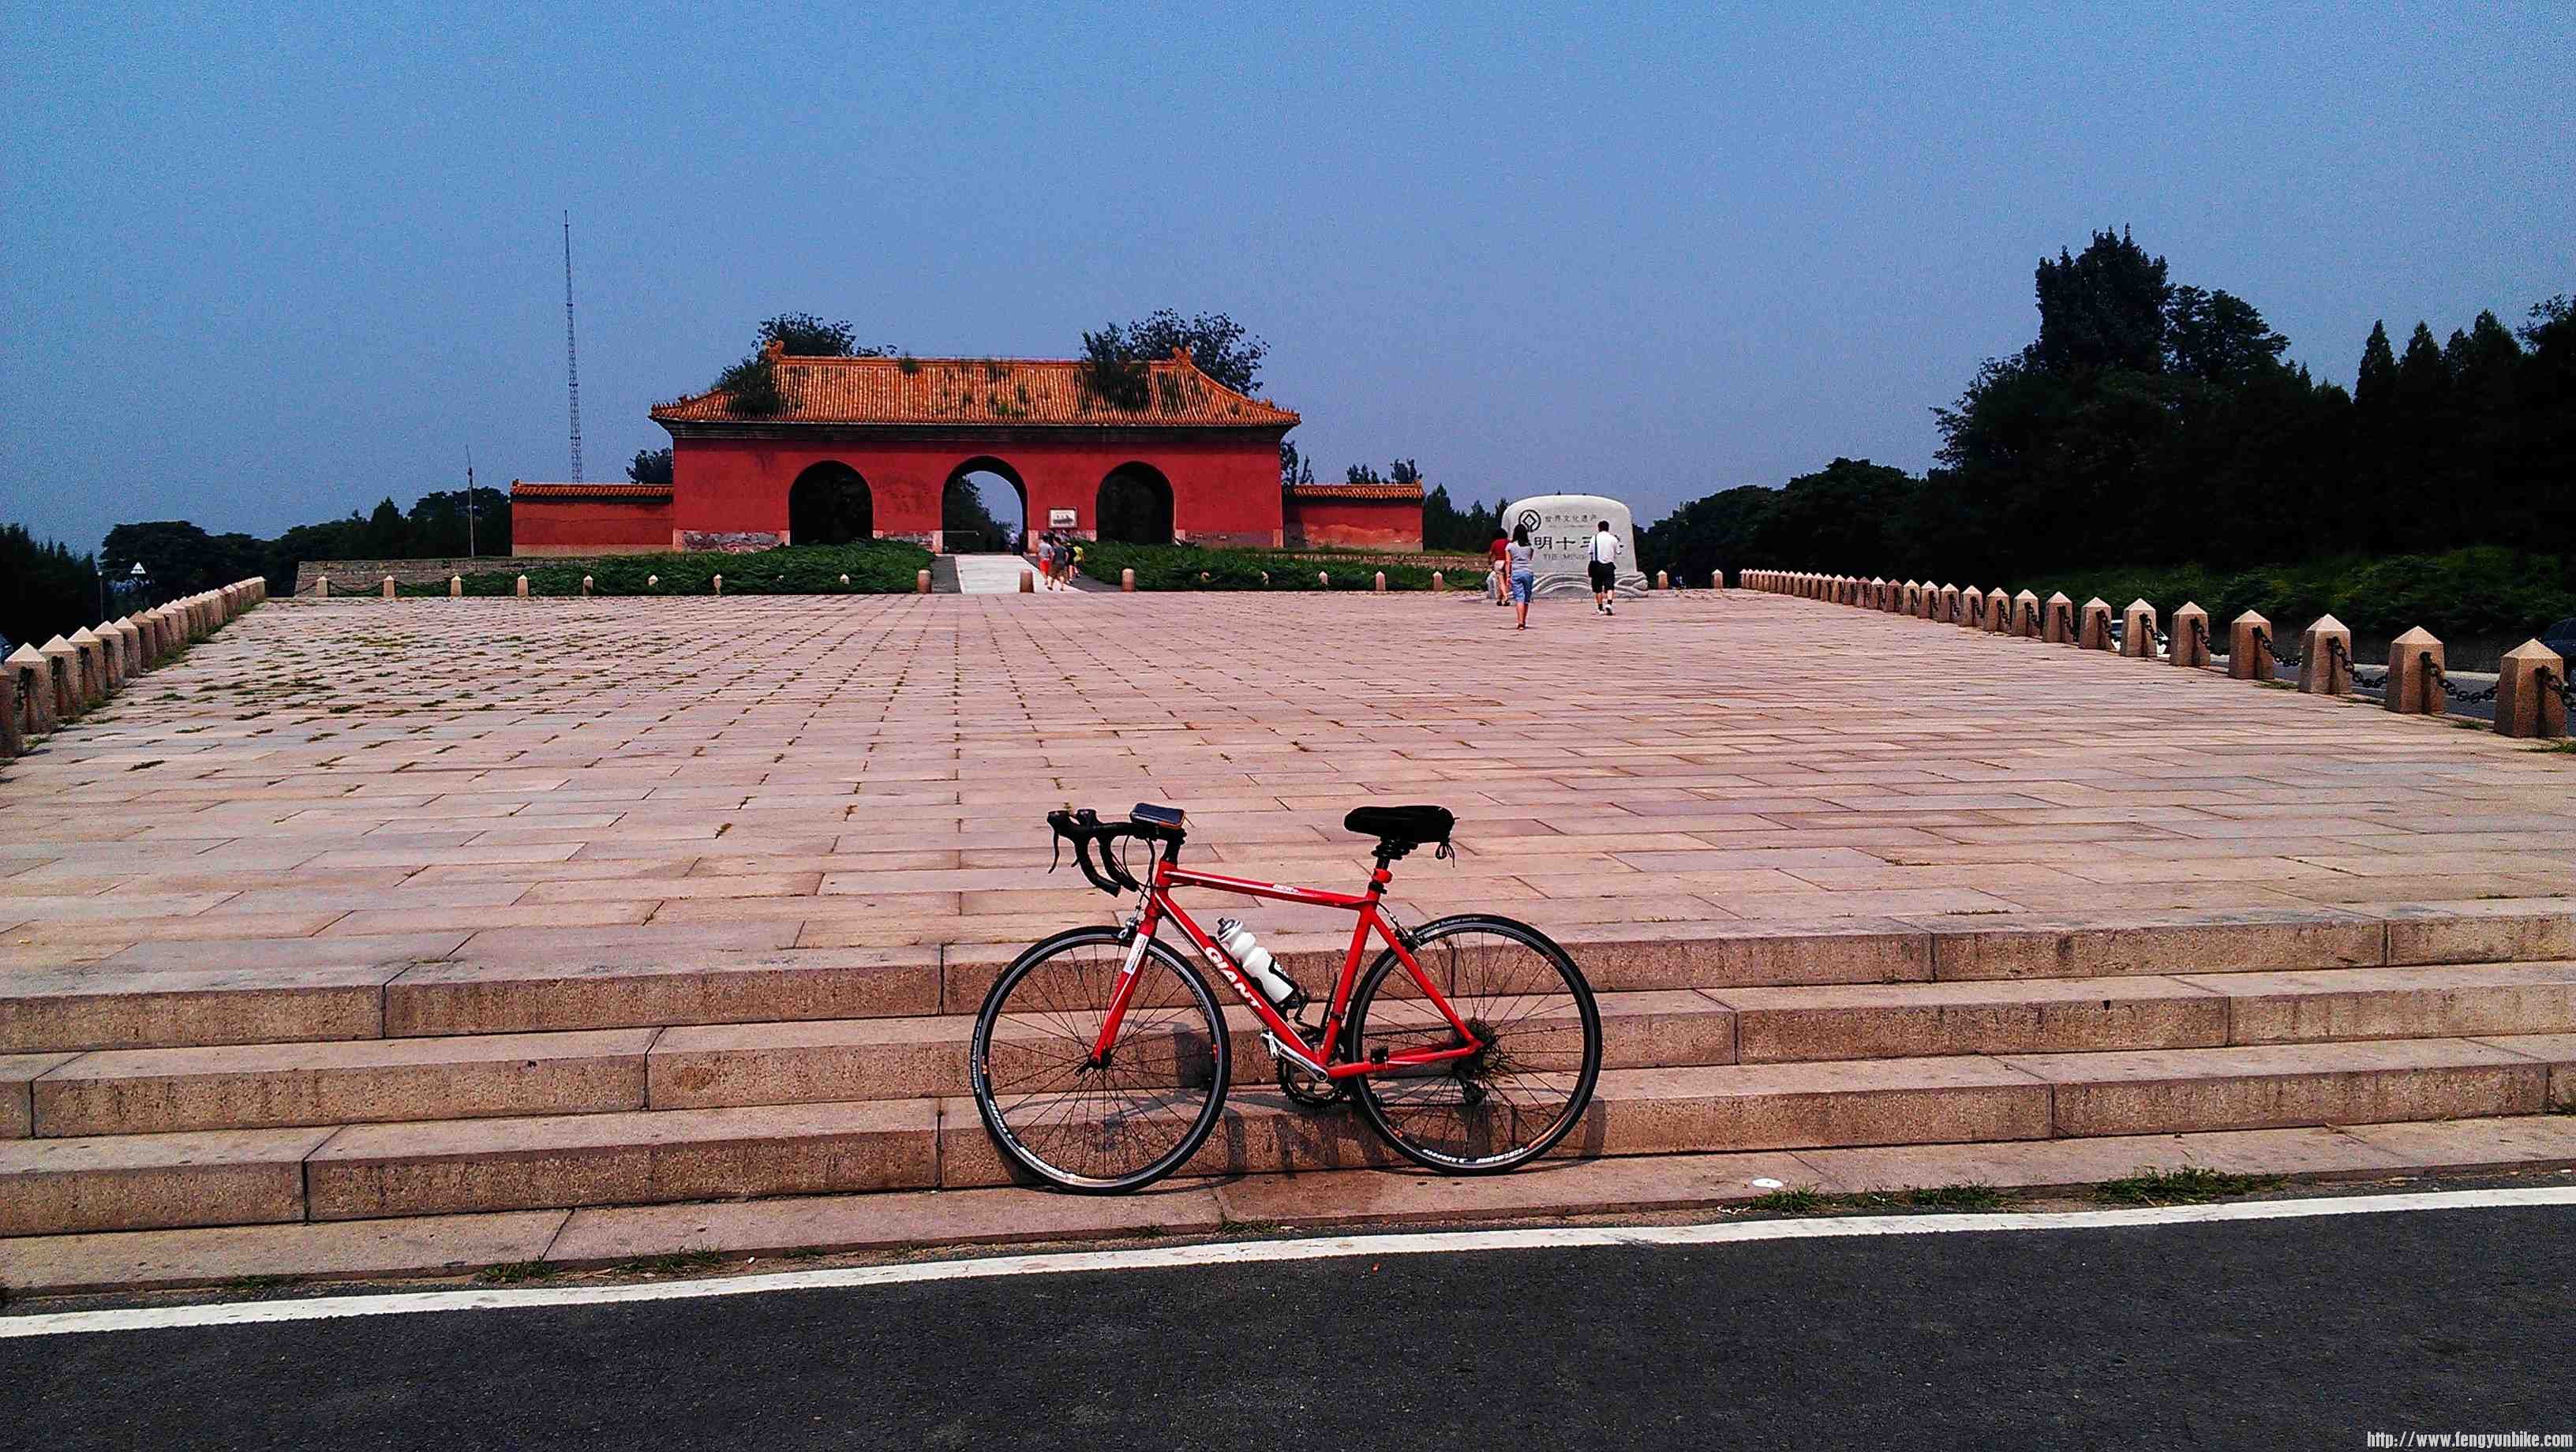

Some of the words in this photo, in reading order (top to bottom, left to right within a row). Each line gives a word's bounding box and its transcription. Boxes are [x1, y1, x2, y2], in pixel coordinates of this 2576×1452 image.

[1533, 536, 1623, 554] 明十三
[1205, 947, 1263, 1009] GIANT
